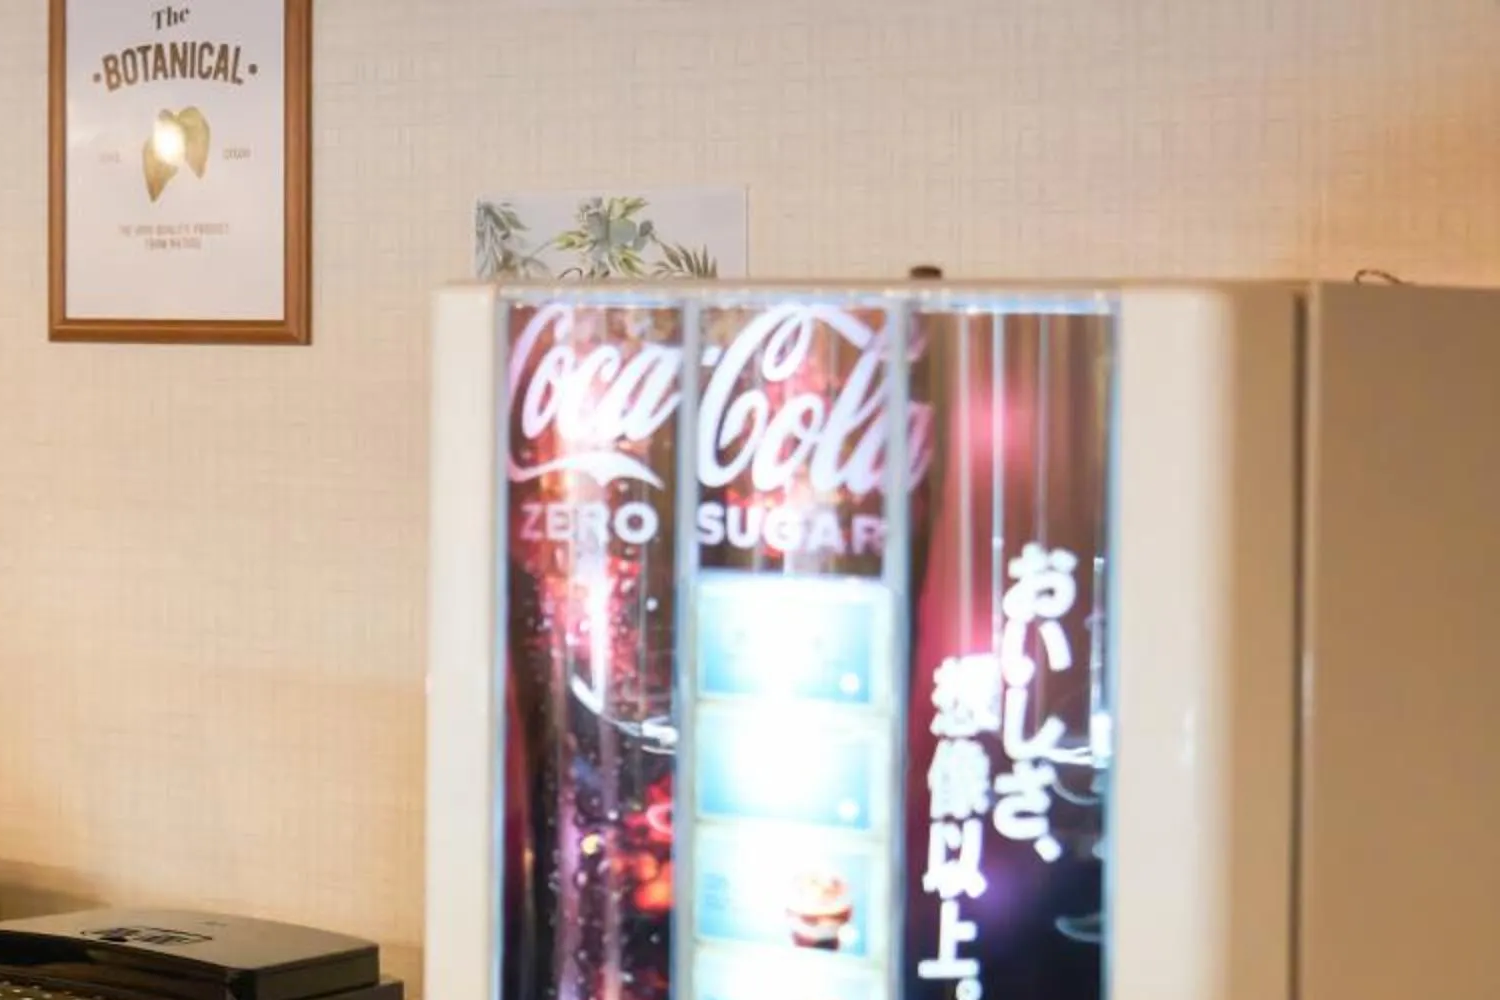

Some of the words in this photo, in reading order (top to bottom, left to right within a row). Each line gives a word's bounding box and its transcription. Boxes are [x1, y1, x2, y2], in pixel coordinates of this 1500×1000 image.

[152, 6, 190, 30] The
[102, 41, 243, 91] BOTANICAL
[521, 502, 659, 544] ZERO
